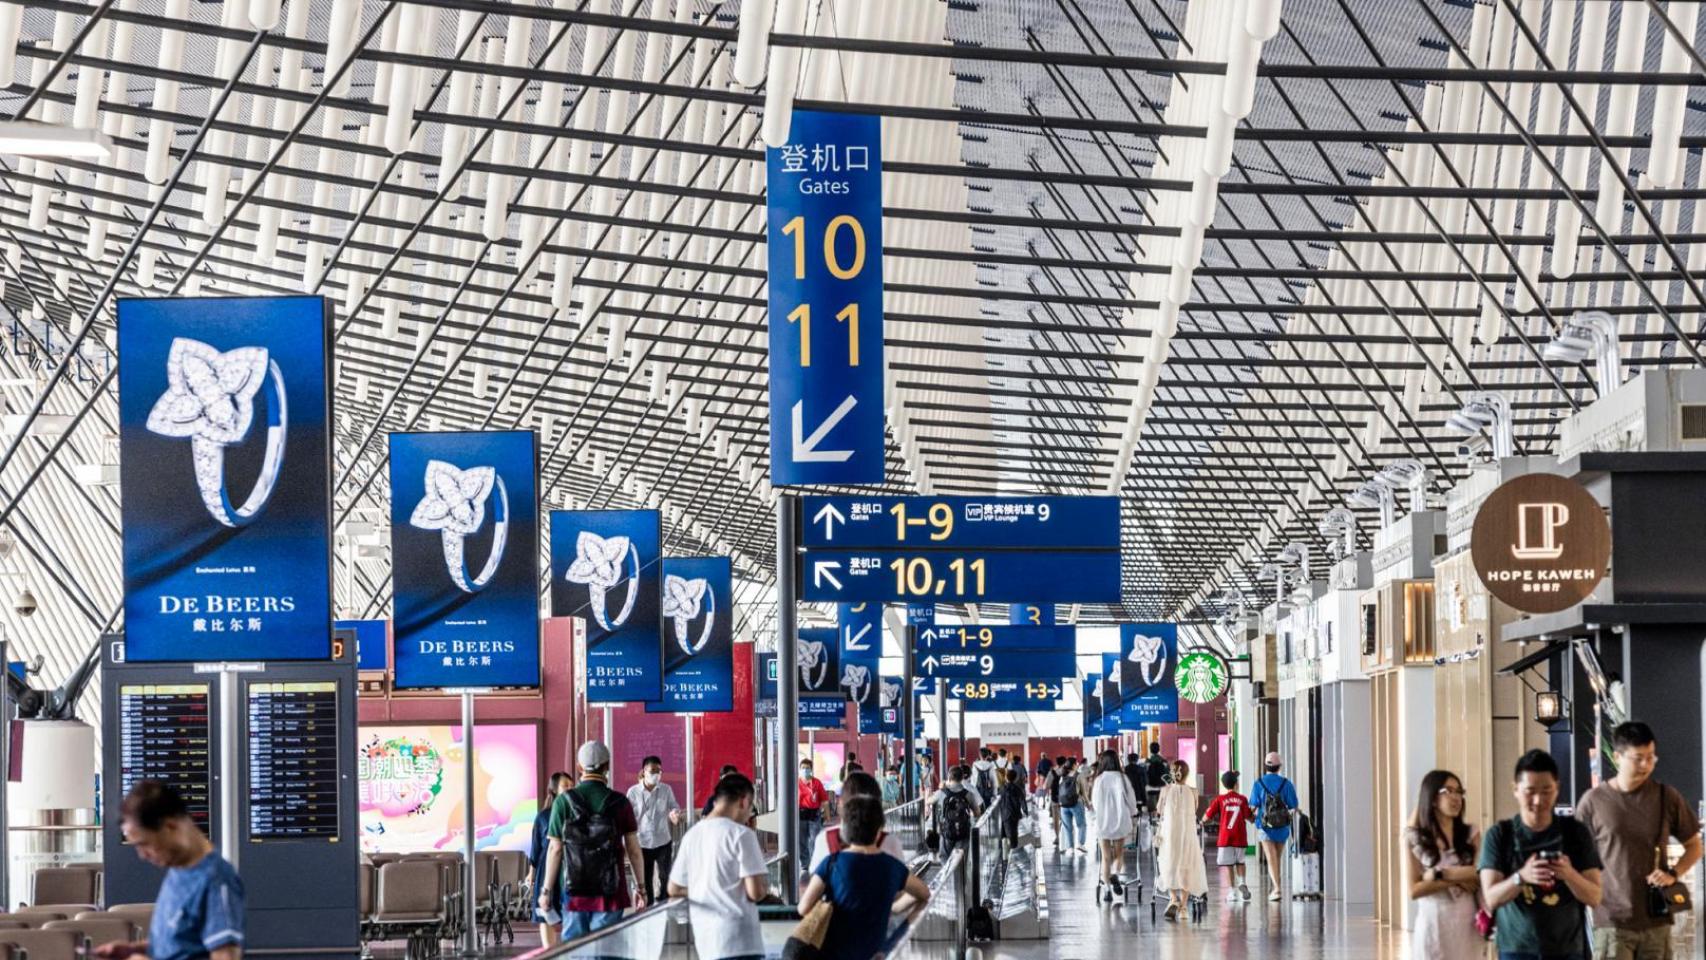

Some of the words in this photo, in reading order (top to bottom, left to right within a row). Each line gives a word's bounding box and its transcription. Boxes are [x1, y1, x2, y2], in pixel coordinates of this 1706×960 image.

[780, 144, 869, 173] 登机口
[799, 178, 850, 194] Gates
[781, 215, 866, 280] 10
[786, 303, 859, 367] 11
[850, 503, 882, 514] 登机口
[983, 504, 1035, 516] 贵宾候机室
[1038, 503, 1050, 522] 9
[849, 558, 881, 569] 登机口
[849, 568, 868, 576] Gates
[890, 557, 985, 596] 10,11
[1487, 570, 1533, 582] HOPE
[1537, 568, 1595, 580] KAWEH
[159, 596, 199, 613] DE
[206, 595, 295, 613] BEERS
[193, 617, 262, 632] 戴比尔斯
[419, 641, 447, 653] DE
[452, 640, 515, 653] BEERS
[442, 656, 491, 667] 戴比尔斯
[980, 655, 994, 676] 9
[596, 666, 643, 677] BEERS
[680, 683, 718, 692] BEERS
[1226, 805, 1241, 830] 7
